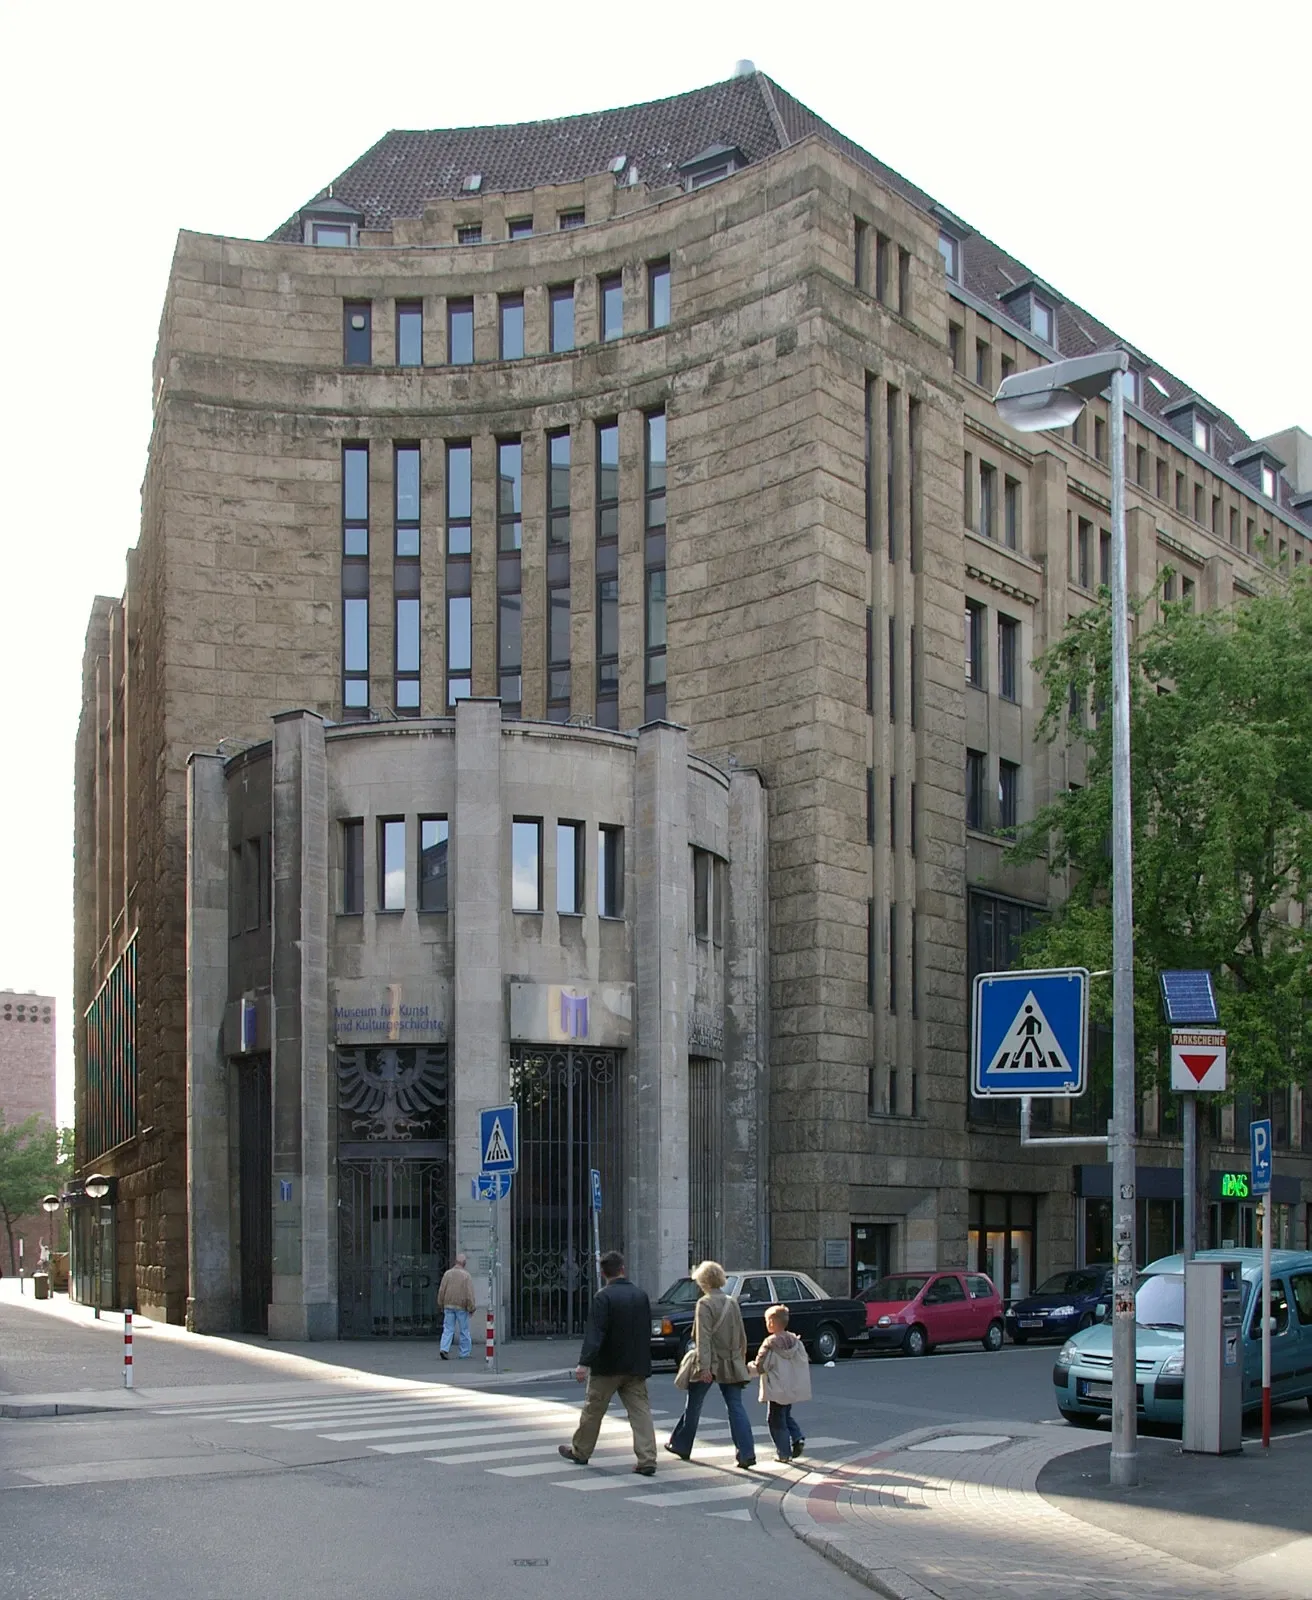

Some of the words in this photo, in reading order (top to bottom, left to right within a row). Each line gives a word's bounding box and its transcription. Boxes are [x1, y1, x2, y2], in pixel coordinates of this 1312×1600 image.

[334, 1006, 377, 1018] Museum
[399, 1003, 429, 1017] Kunst
[333, 1020, 353, 1033] und
[356, 1017, 445, 1033] Kulturgeschichte
[1173, 1035, 1225, 1046] PARKSCHEINE
[1254, 1127, 1267, 1167] P
